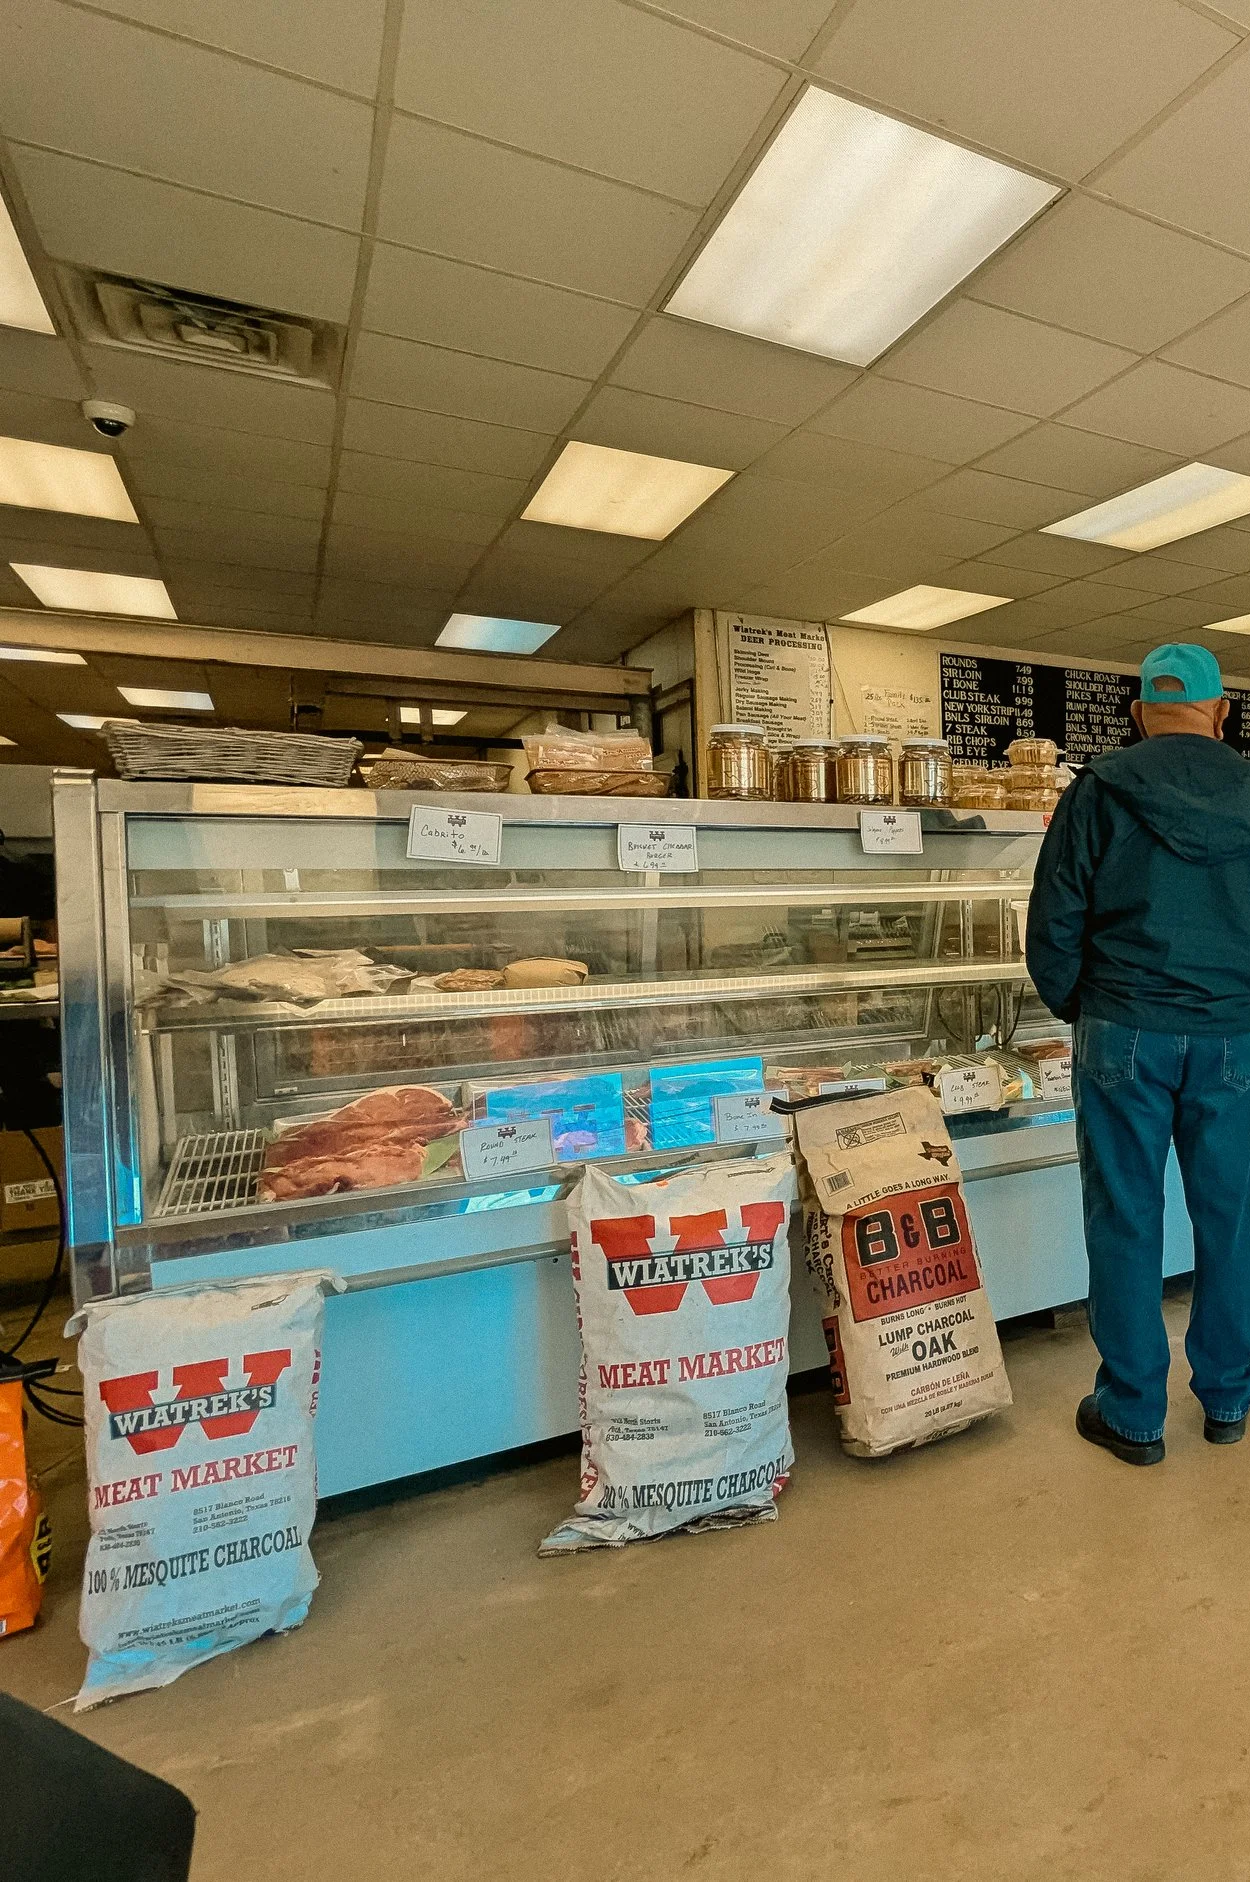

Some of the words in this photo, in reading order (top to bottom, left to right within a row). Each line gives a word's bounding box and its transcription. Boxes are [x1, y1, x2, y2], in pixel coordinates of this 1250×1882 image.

[740, 635, 765, 644] DEER
[768, 638, 823, 651] PROCESSING
[942, 656, 977, 668] ROUNDS
[942, 668, 982, 680] SIRLOIN
[1065, 670, 1091, 680] CHUCK
[1094, 673, 1120, 684] ROAST
[943, 678, 950, 687] T
[953, 679, 979, 690] BONE
[1065, 681, 1104, 692] SHOULDER
[1106, 685, 1131, 695] ROAST
[1066, 690, 1091, 700] PIKES
[1097, 693, 1120, 703] PEAK
[944, 702, 964, 711] NEW
[966, 703, 990, 714] YORK
[1066, 702, 1087, 711] RUMP
[1089, 704, 1116, 714] ROAST
[945, 712, 969, 722] BNLS
[975, 714, 1009, 726] SIRLOIN
[1066, 712, 1084, 721] LOIN
[1088, 714, 1102, 723] TIP
[1104, 716, 1129, 726] ROAST
[946, 723, 952, 732] 7
[956, 724, 987, 735] STEAK
[1066, 723, 1087, 732] BNLS
[1107, 727, 1131, 736] ROAST
[947, 735, 962, 744] RIB
[965, 736, 996, 746] CHOPS
[1065, 733, 1092, 743] CROWN
[1096, 735, 1121, 745] ROAST
[967, 747, 988, 756] EYE
[1065, 742, 1100, 752] STANDING
[1066, 754, 1085, 762] BEEF
[854, 1190, 881, 1207] LITTLE
[882, 1183, 904, 1196] GOES
[905, 1181, 911, 1189] A
[912, 1177, 932, 1188] LONG
[612, 1243, 772, 1287] WIATREK'S
[866, 1259, 968, 1304] CHARCOAL
[880, 1313, 905, 1326] BURNS
[906, 1307, 925, 1319] LONG
[934, 1299, 955, 1311] BURNS
[955, 1295, 967, 1305] HOT
[878, 1326, 914, 1347] LUMP
[916, 1309, 975, 1336] CHARCOAL
[911, 1330, 958, 1362] OAK
[598, 1359, 671, 1389] MEAT
[678, 1337, 785, 1382] MARKET
[885, 1365, 921, 1382] PREMIUM
[922, 1352, 961, 1371] HARDWOOD
[962, 1345, 979, 1359] BLEND
[942, 1378, 952, 1387] DE
[113, 1386, 273, 1437] WIATREK'S
[703, 1411, 721, 1419] 8517
[723, 1406, 747, 1417] Blanco
[748, 1400, 766, 1411] Road
[704, 1420, 718, 1428] San
[750, 1409, 768, 1420] Texas
[94, 1473, 162, 1510] MEAT
[170, 1445, 298, 1493] MARKET
[632, 1478, 712, 1512] MESQUITE
[716, 1455, 787, 1500] CHARCOAL
[214, 1498, 244, 1512] Blanco
[244, 1493, 265, 1504] Road
[193, 1516, 209, 1525] San
[245, 1501, 268, 1512] Texas
[88, 1570, 107, 1595] 100
[123, 1548, 210, 1590] MESQUITE
[213, 1525, 302, 1568] CHARCOAL
